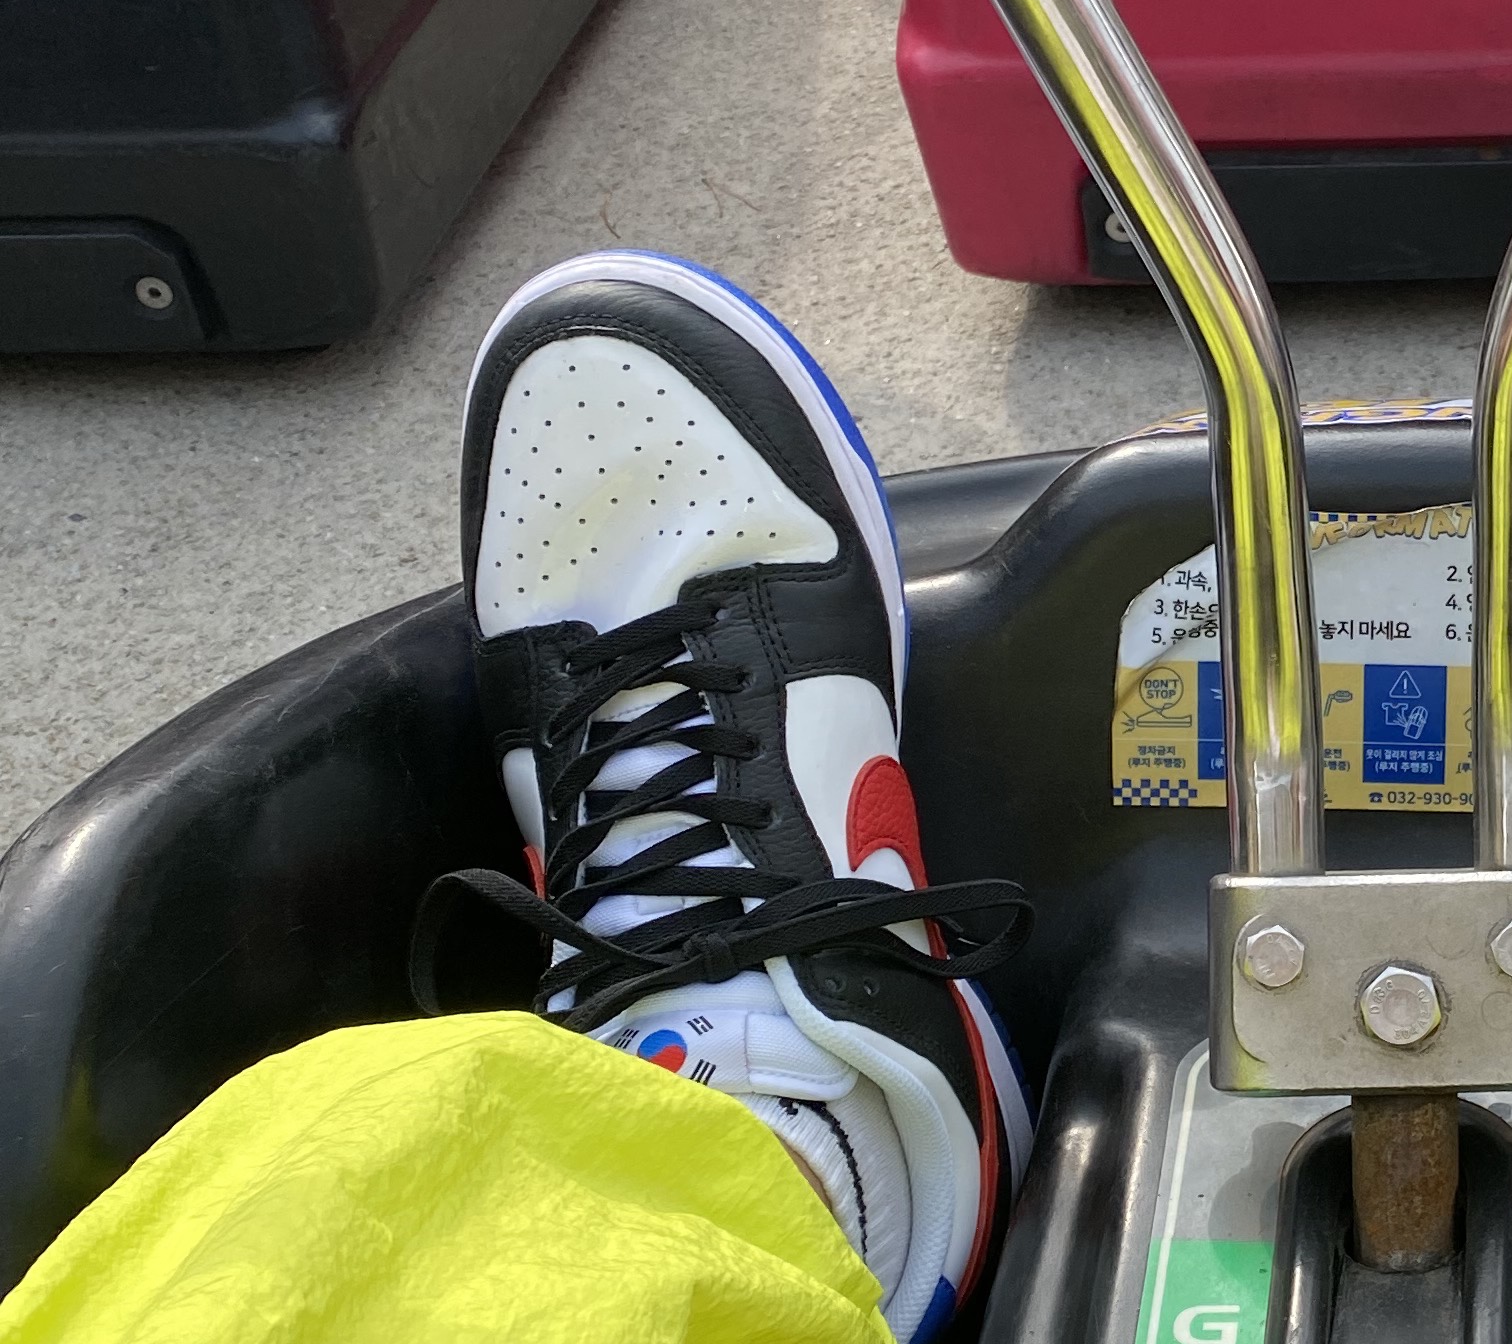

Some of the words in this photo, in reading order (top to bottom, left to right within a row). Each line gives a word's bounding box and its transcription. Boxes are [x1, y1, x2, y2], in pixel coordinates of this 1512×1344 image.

[1446, 565, 1463, 583] 2.
[1154, 598, 1168, 617] 3.
[1445, 594, 1462, 611] 4.
[1151, 627, 1166, 645] 5.
[1319, 619, 1354, 641] 놓지
[1358, 619, 1412, 642] 마세요
[1445, 623, 1461, 641] 6.
[1144, 679, 1179, 689] DON'T
[1146, 689, 1177, 700] STOP
